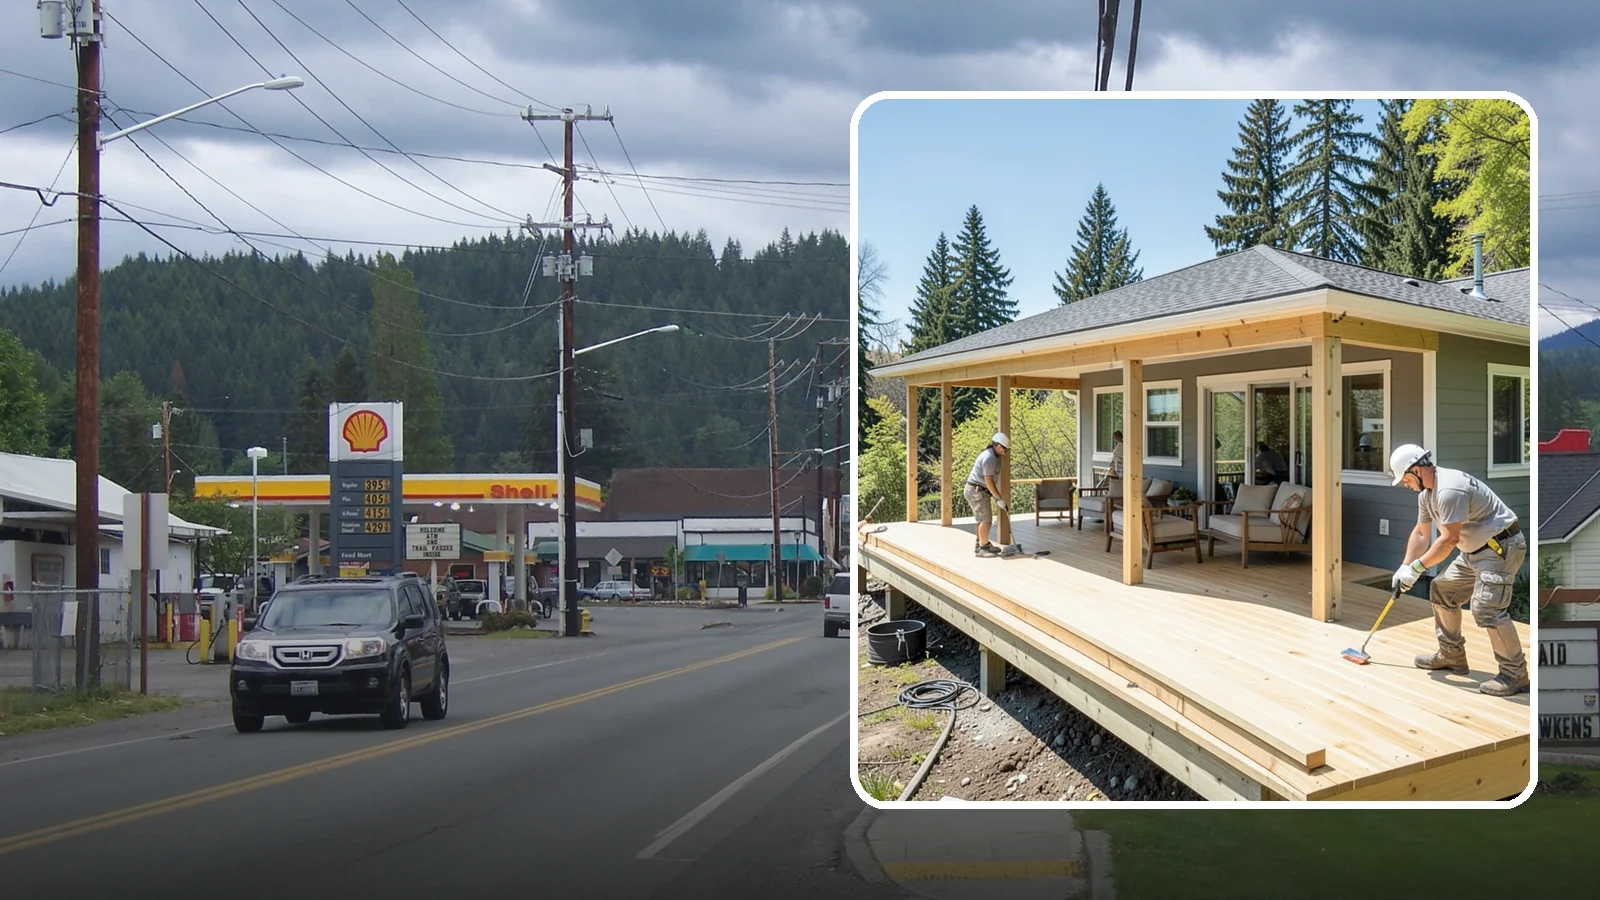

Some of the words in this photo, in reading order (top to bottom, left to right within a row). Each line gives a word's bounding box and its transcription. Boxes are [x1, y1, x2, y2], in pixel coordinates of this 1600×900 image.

[366, 480, 383, 490] 395
[490, 484, 547, 499] Shell
[365, 494, 383, 504] 405
[365, 508, 383, 518] 415
[366, 522, 383, 532] 429
[1538, 642, 1567, 666] AID
